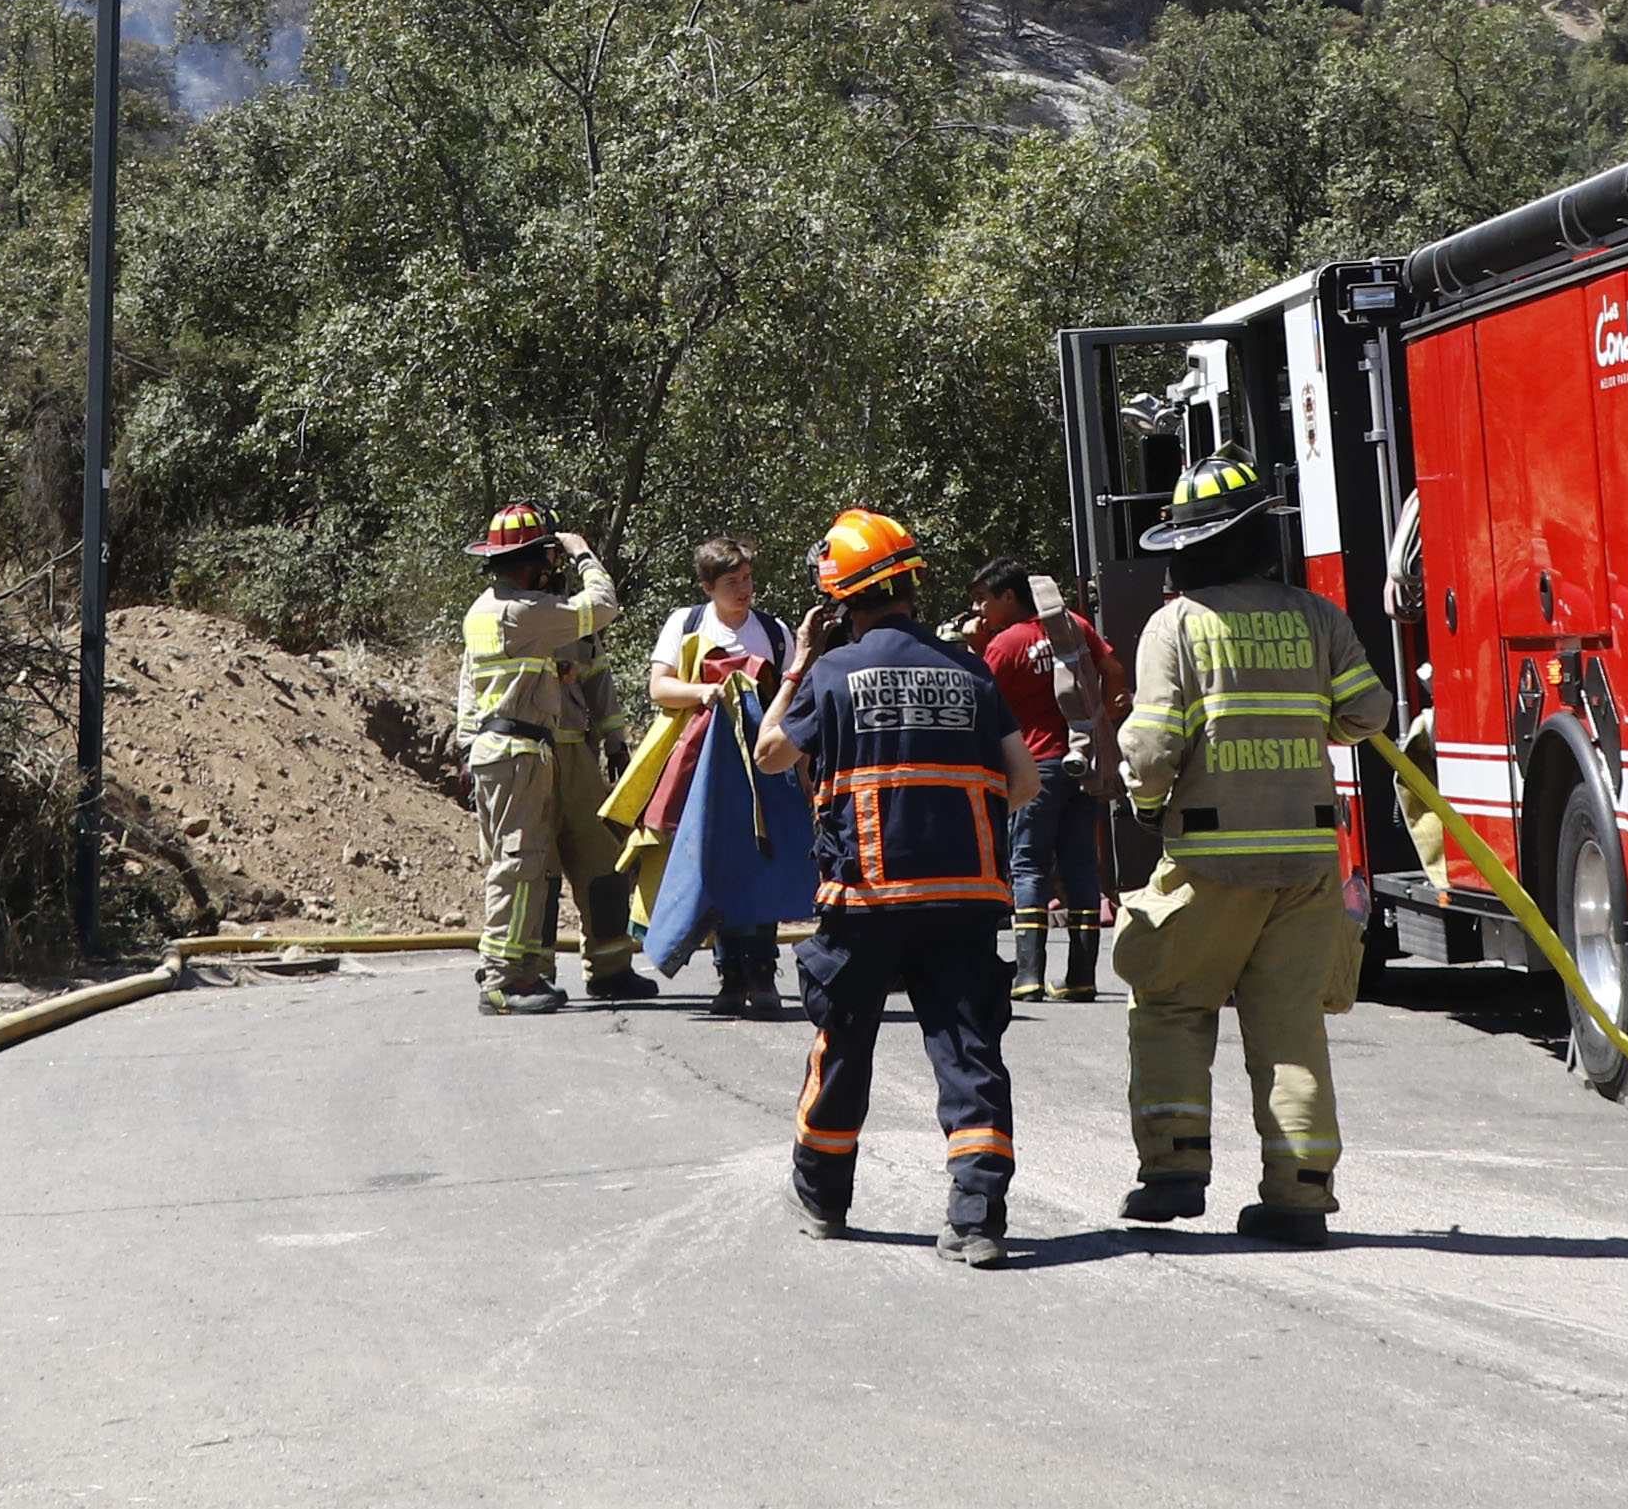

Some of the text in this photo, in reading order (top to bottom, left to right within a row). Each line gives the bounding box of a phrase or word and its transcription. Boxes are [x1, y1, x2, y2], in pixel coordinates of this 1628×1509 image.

[1602, 294, 1620, 323] Las
[1185, 611, 1310, 641] BOMBEROS
[1192, 639, 1315, 672] SANTIAGO
[851, 669, 973, 690] INVESTIGACION
[853, 687, 975, 708] INCENDIOS
[862, 707, 970, 727] CBS
[1206, 737, 1323, 773] FORESTAL
